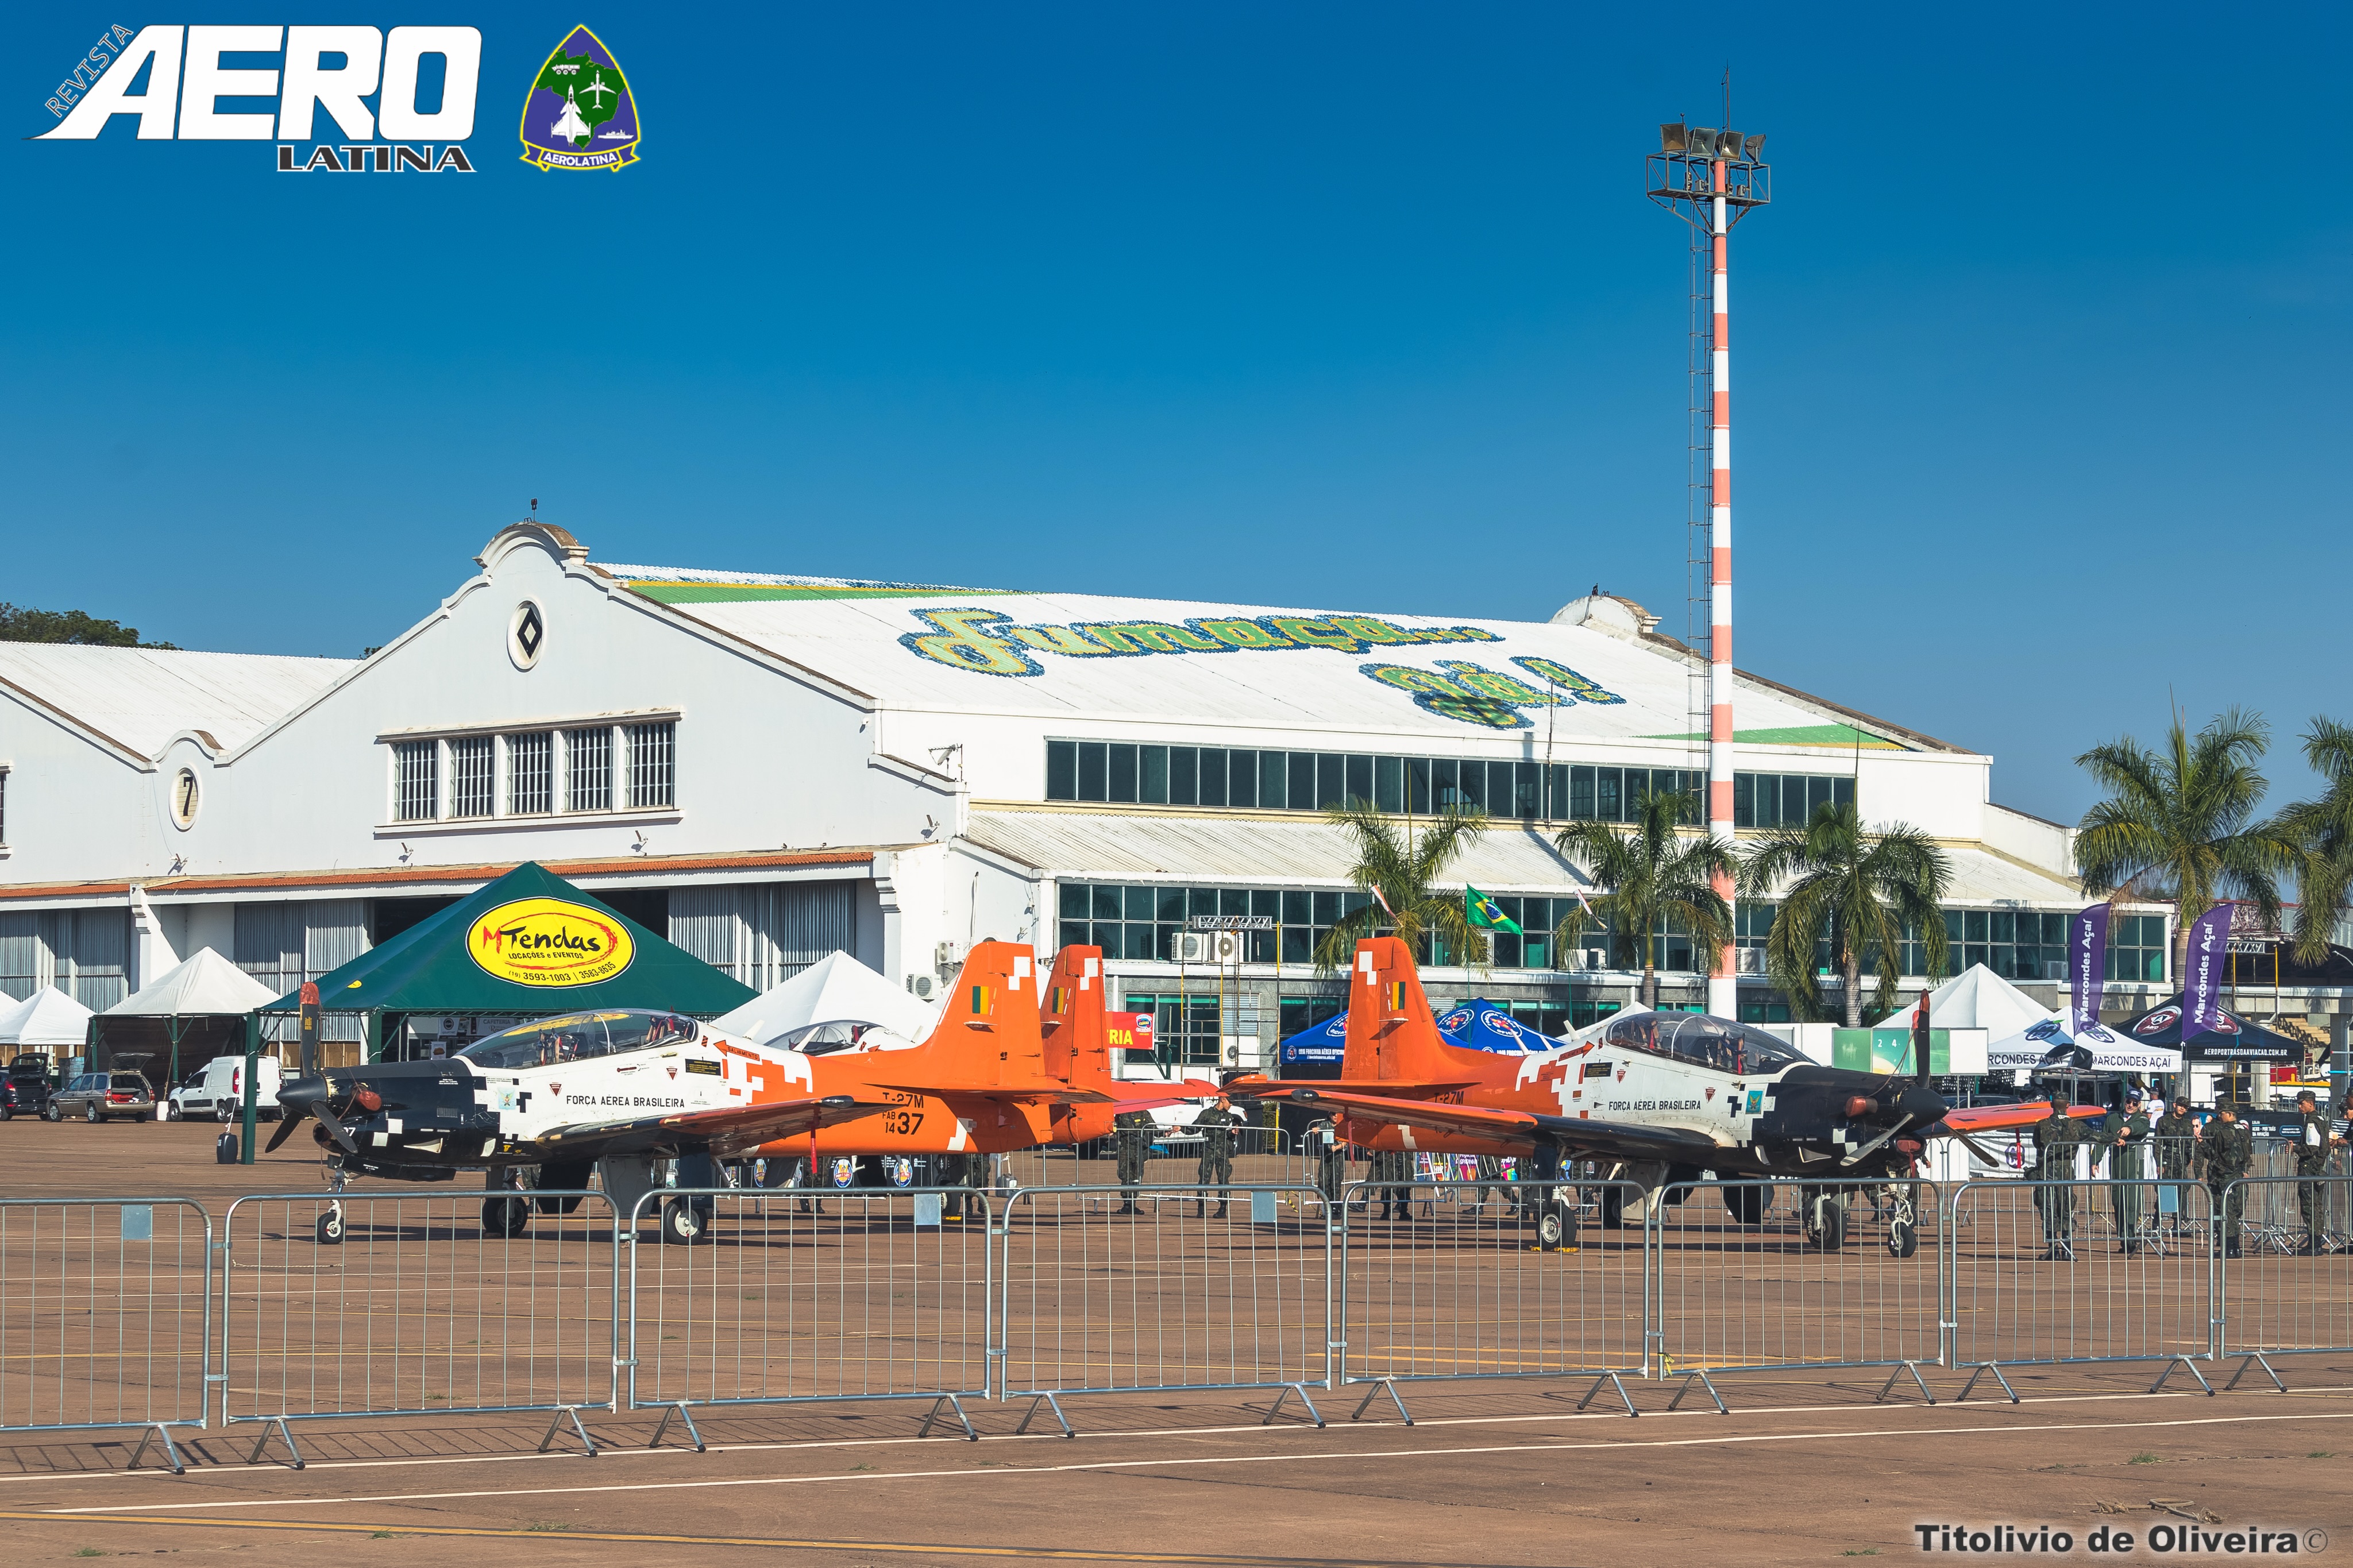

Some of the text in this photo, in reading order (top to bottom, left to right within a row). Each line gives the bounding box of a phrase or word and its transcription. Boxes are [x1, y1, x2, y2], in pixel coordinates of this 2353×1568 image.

[183, 777, 193, 816] 7
[508, 951, 545, 960] LOCAÇÕES
[508, 961, 616, 982] (19) 3593-1003 3583-8635
[2080, 918, 2094, 1022] Marcondes Açaí
[2194, 922, 2216, 1023] Marcondes Açaí
[1106, 1029, 1133, 1045] RIA
[727, 1046, 758, 1060] SALVAMENTO
[2092, 1055, 2170, 1070] MARCONDES AÇAÍ
[566, 1095, 596, 1106] FORÇA
[601, 1095, 630, 1106] AÉREA
[634, 1097, 685, 1107] BRASILEIRA
[882, 1092, 924, 1109] T-27M
[1434, 1091, 1464, 1105] T-27M
[1609, 1099, 1700, 1112] FORÇA AÉREA BRASILEIRA
[882, 1111, 896, 1120] FAB
[885, 1122, 895, 1134] 14
[897, 1112, 924, 1135] 37
